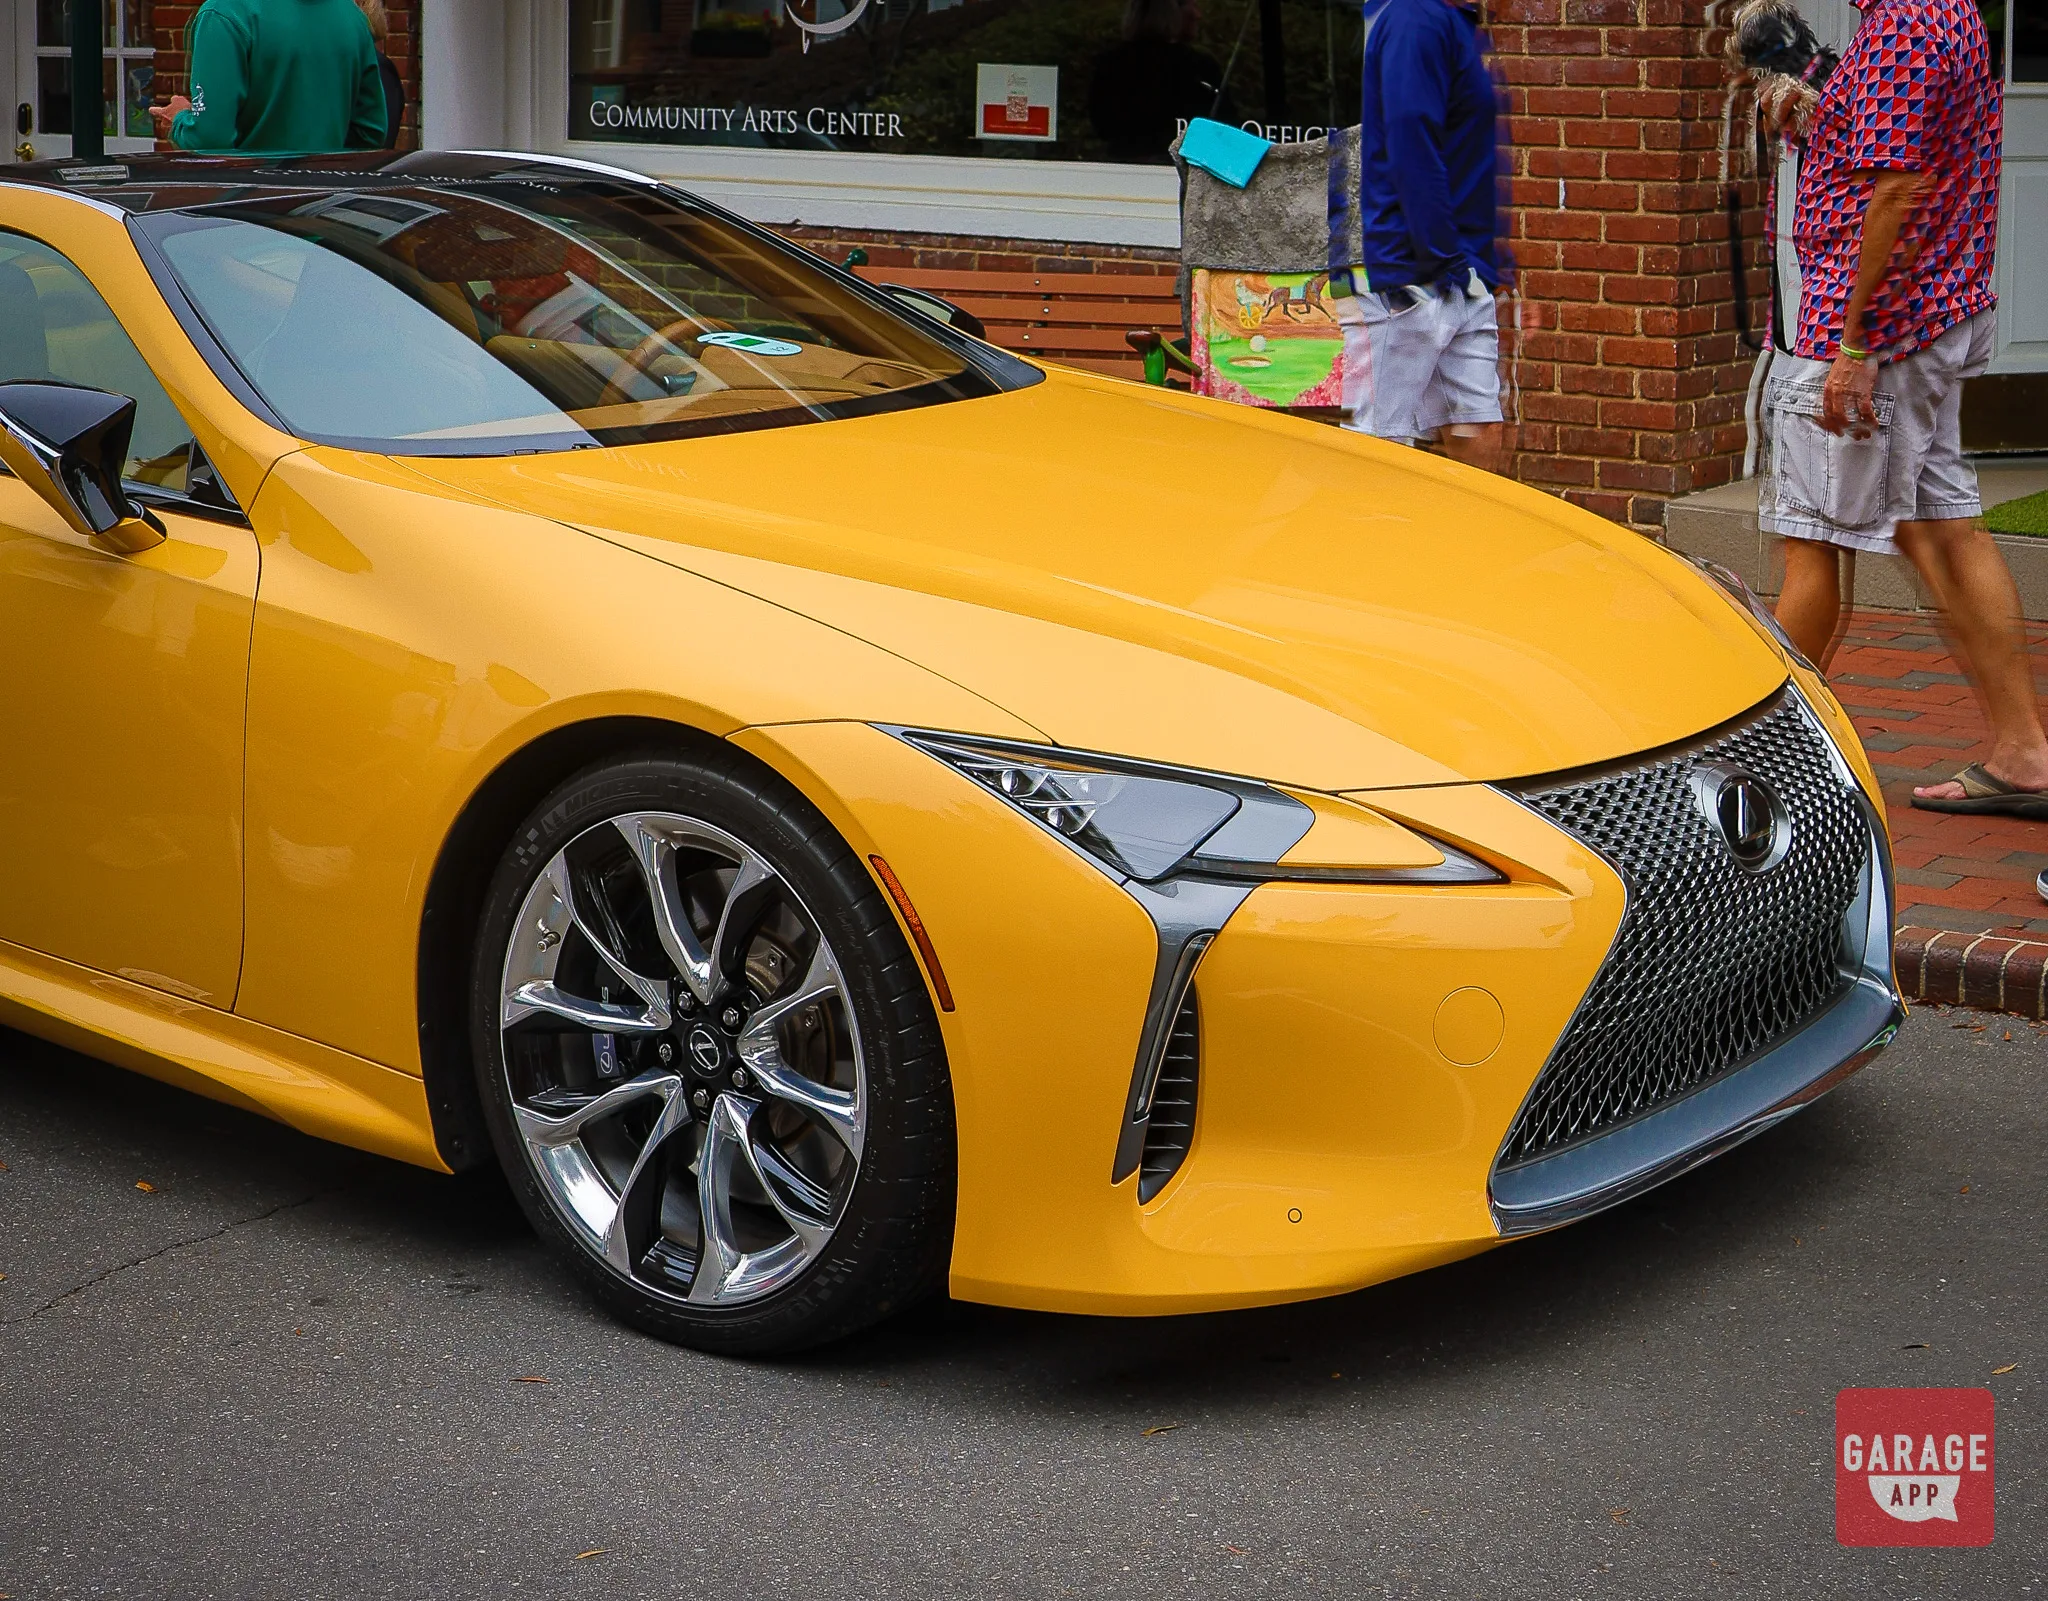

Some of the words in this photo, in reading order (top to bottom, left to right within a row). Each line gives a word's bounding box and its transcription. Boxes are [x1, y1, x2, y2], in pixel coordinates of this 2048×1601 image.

[589, 100, 736, 131] COMMUNITY
[741, 106, 798, 134] ARTS
[806, 107, 905, 137] CENTER
